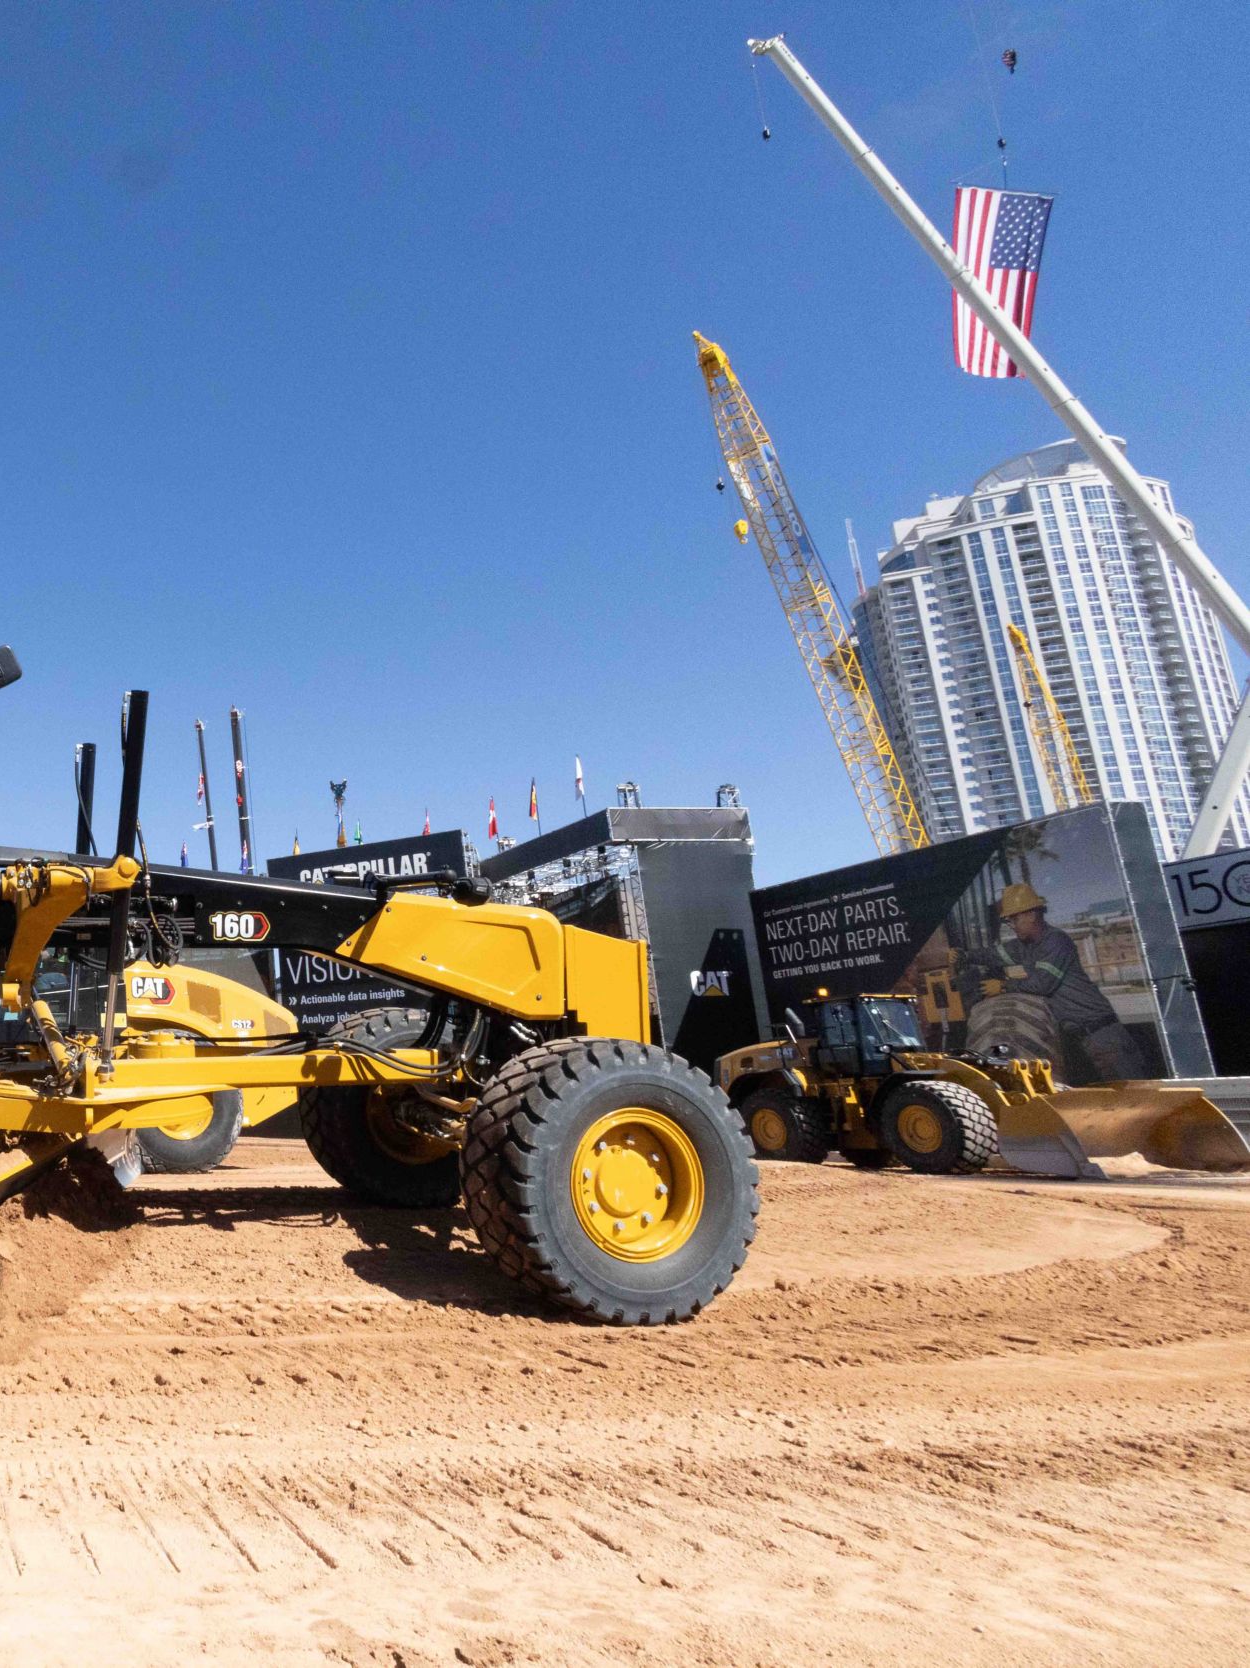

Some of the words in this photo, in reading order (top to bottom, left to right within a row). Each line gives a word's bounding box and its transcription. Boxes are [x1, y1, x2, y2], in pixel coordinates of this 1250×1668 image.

[212, 914, 254, 939] 160
[765, 908, 838, 941] NEXT-DAY
[843, 896, 905, 925] PARTS.
[769, 933, 840, 965] TWO-DAY
[773, 966, 803, 979] GETTING
[804, 963, 820, 974] YOU
[820, 960, 842, 971] BACK
[843, 958, 854, 968] TO
[131, 977, 166, 999] CAT
[690, 970, 731, 997] CAT
[300, 993, 346, 1005] Actionable
[347, 991, 367, 1001] data
[369, 988, 405, 1001] insights
[301, 1013, 335, 1025] Analyze
